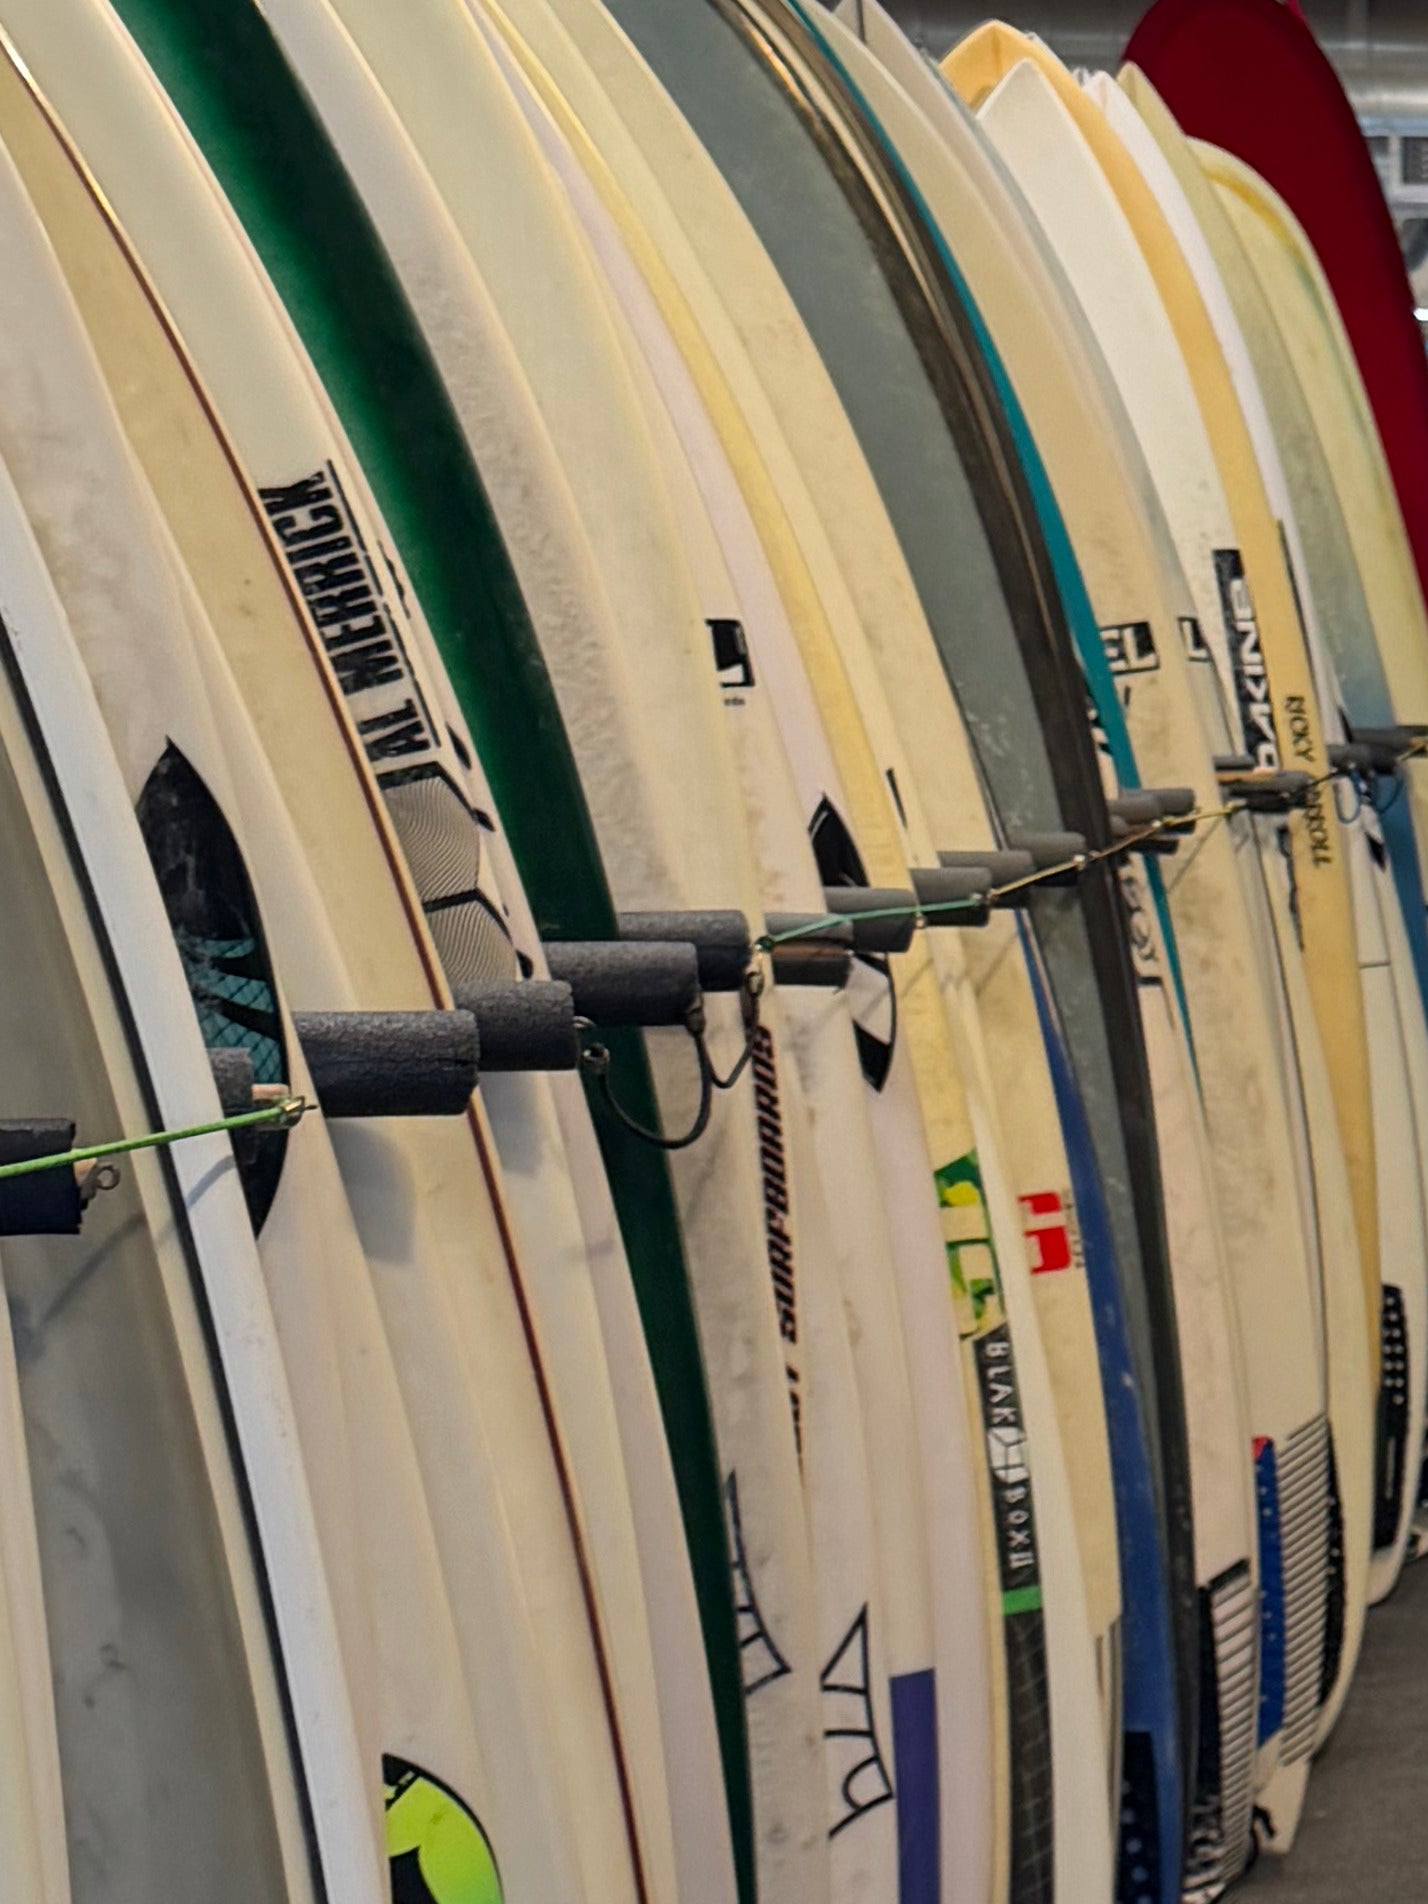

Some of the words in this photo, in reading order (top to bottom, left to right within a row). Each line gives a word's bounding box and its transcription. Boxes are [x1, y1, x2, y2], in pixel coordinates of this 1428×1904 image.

[257, 469, 404, 696] MERRICK
[1229, 577, 1280, 774] DAKINE
[356, 697, 433, 763] AL
[751, 1023, 798, 1345] SURFBOARDS
[984, 1340, 1016, 1423] BLAK
